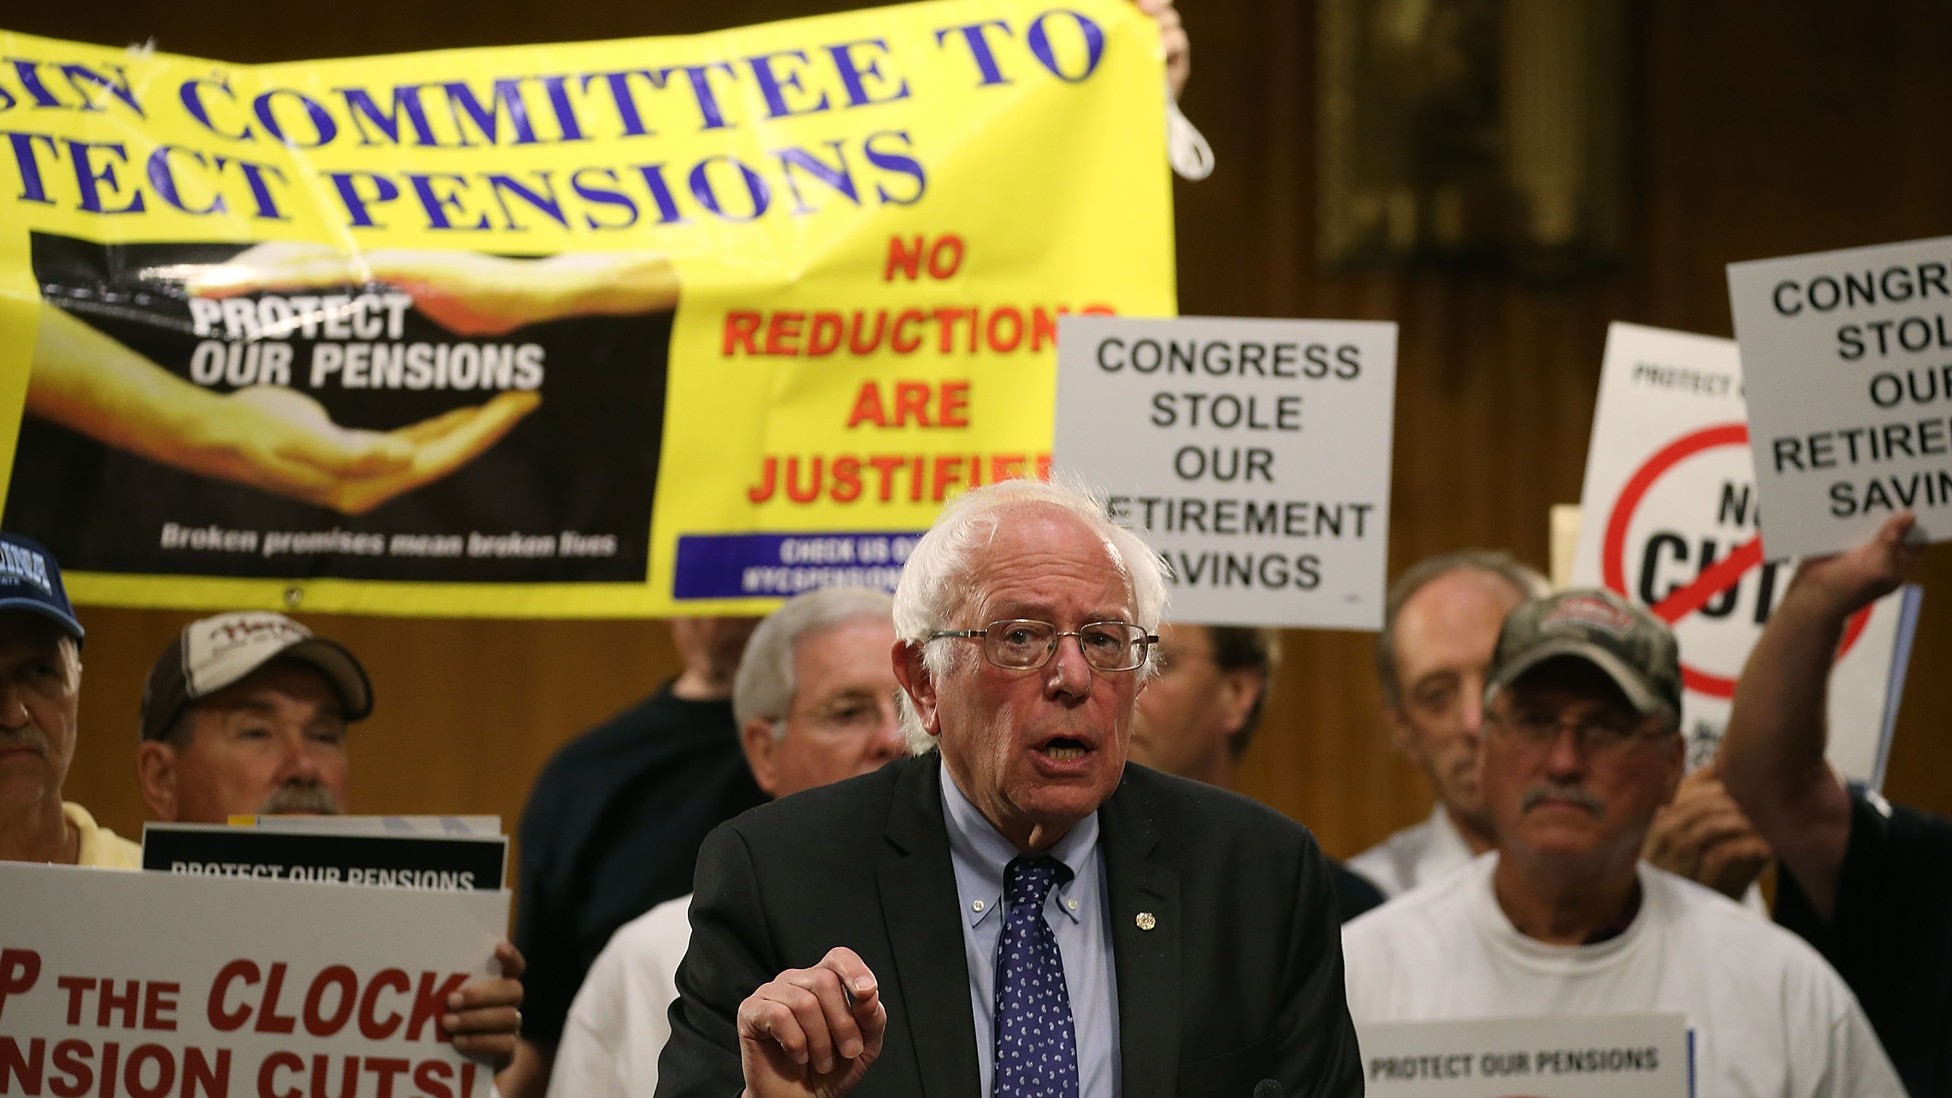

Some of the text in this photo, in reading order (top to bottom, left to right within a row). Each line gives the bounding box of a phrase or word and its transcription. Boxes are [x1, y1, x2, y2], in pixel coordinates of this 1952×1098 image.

[179, 39, 911, 148] COMMITTEE
[936, 8, 1107, 87] TO
[0, 130, 927, 230] TECT PENSIONS
[882, 234, 965, 281] NO
[189, 293, 412, 342] PROTECT
[721, 302, 1116, 358] REDUCTION
[190, 341, 546, 391] OUR PENSIONS
[1097, 337, 1361, 380] CONGRESS
[1631, 362, 1732, 398] PROTECT
[847, 379, 971, 428] ARE
[1869, 365, 1952, 408] OU
[1151, 392, 1303, 431] STOLE
[1174, 446, 1275, 482] OUR
[1772, 418, 1952, 472] RETIRE
[747, 454, 1053, 503] JUSTIFIE
[161, 522, 617, 557] Broken promises mean broken lives
[1107, 496, 1374, 538] ETIREMENT
[779, 537, 855, 565] CHECK
[857, 536, 890, 564] US
[1155, 550, 1321, 590] AVINGS
[171, 860, 476, 892] PROTECT OUR PENSIONS
[57, 975, 180, 1031] THE
[207, 958, 471, 1043] CLOCK
[0, 1035, 232, 1098] NSION
[1370, 1045, 1660, 1081] PROTECT OUR PENSIONS
